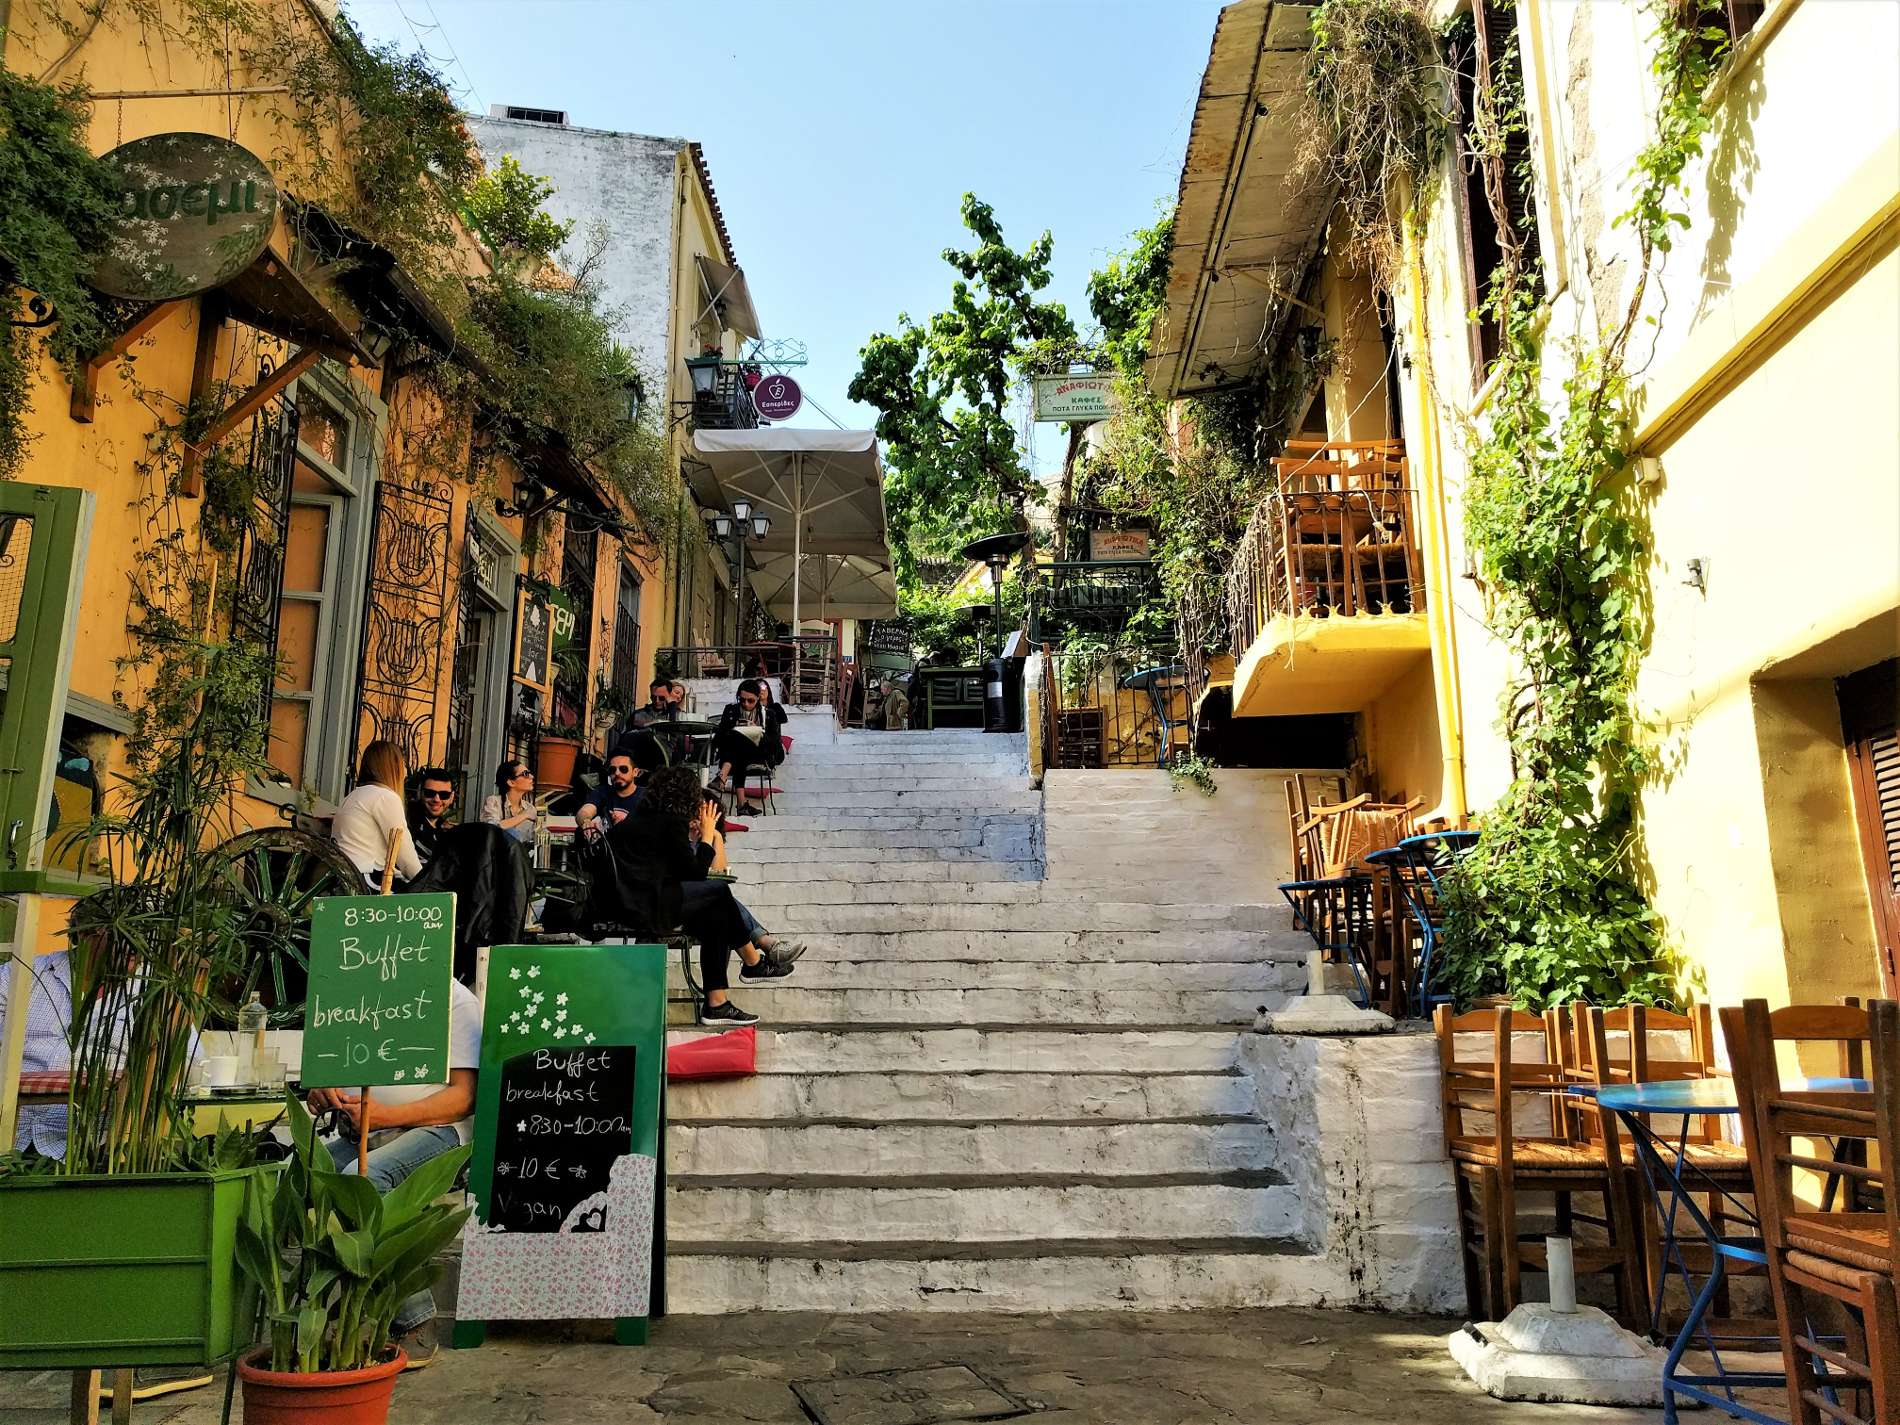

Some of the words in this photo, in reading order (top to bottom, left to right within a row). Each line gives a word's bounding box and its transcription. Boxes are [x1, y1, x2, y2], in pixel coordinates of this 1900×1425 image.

[1055, 381, 1109, 396] ΑΝΑΦΙΩΤ
[344, 905, 442, 927] 8:30-10:00
[339, 934, 432, 981] Buffet
[313, 989, 433, 1032] breakfast
[532, 1048, 611, 1078] Buffet
[506, 1079, 600, 1106] breakfast
[497, 1191, 562, 1225] Vgan
